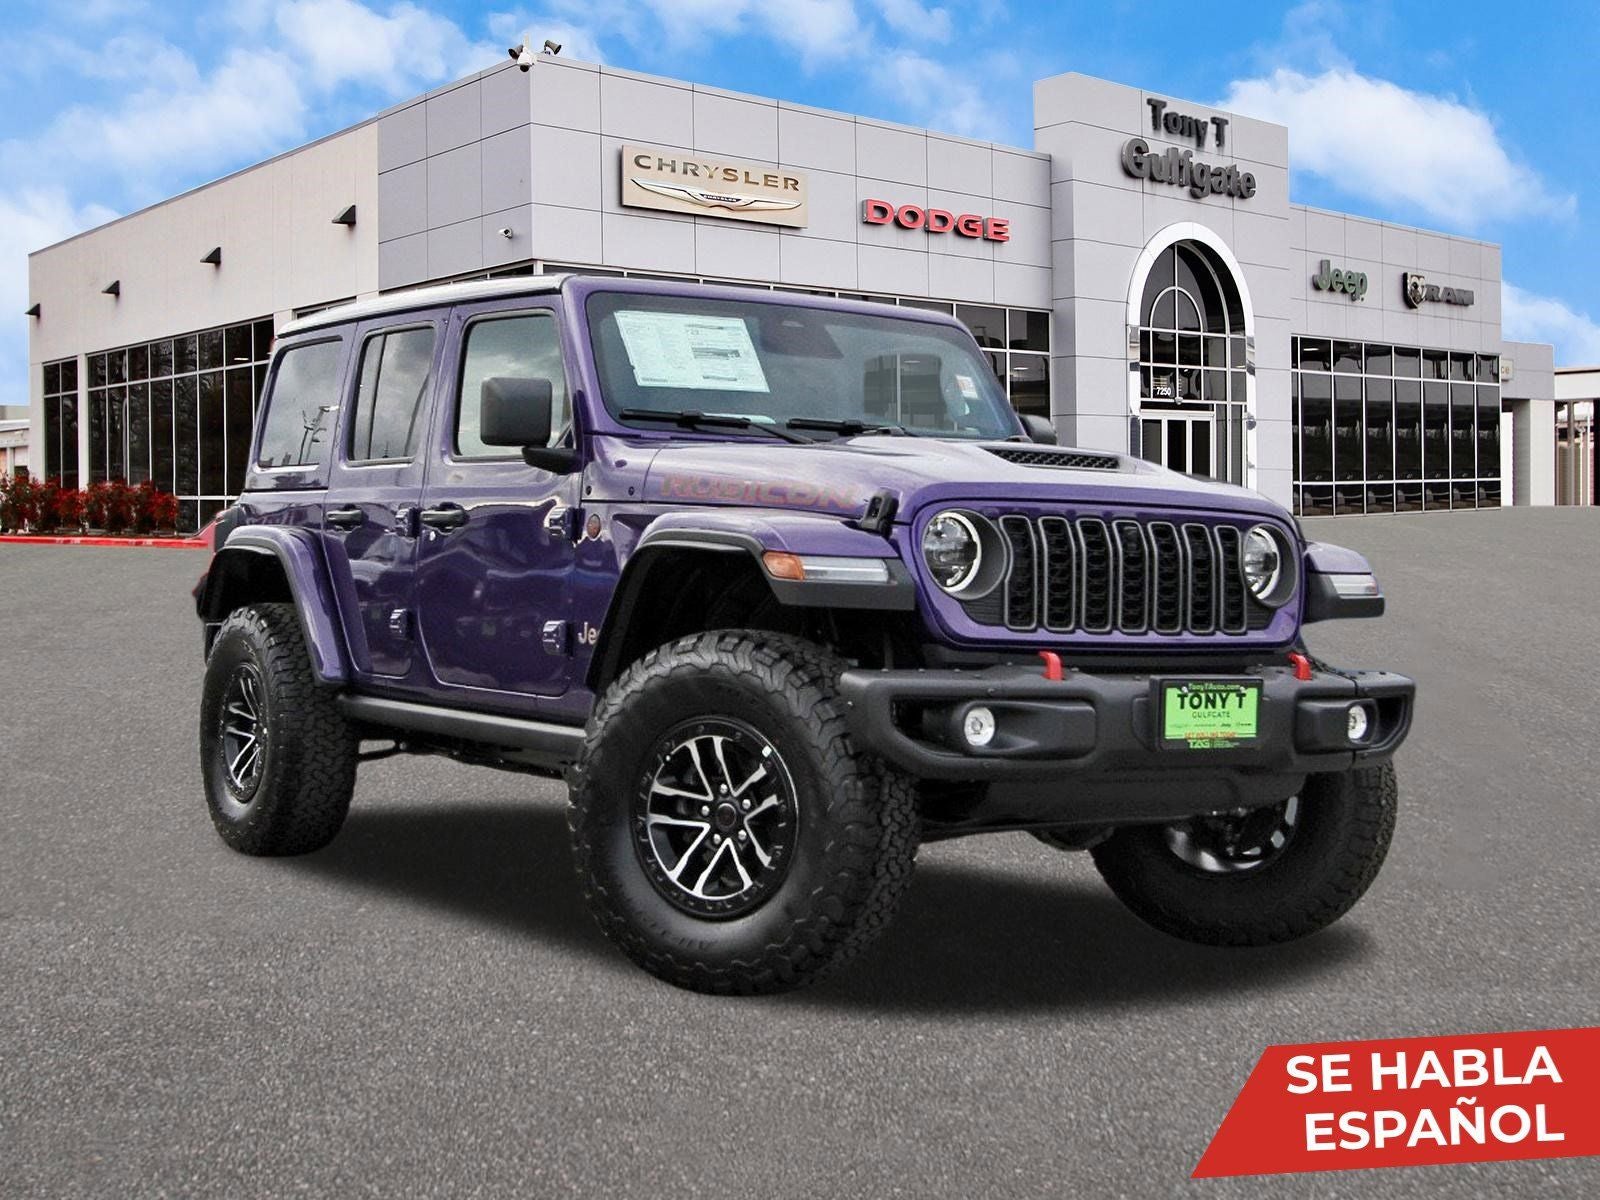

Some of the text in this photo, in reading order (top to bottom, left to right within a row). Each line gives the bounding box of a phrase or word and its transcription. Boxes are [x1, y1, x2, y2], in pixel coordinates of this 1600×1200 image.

[1146, 98, 1229, 148] Tony T
[633, 154, 800, 192] CHRYSLER
[1121, 138, 1256, 199] Gulfgate
[863, 199, 1010, 242] DODGE
[1312, 259, 1368, 302] Jeep
[1424, 284, 1475, 306] RAM
[1156, 386, 1172, 396] 7250
[660, 474, 860, 509] RUBICON
[577, 621, 600, 645] Je
[1177, 692, 1247, 710] TONY T
